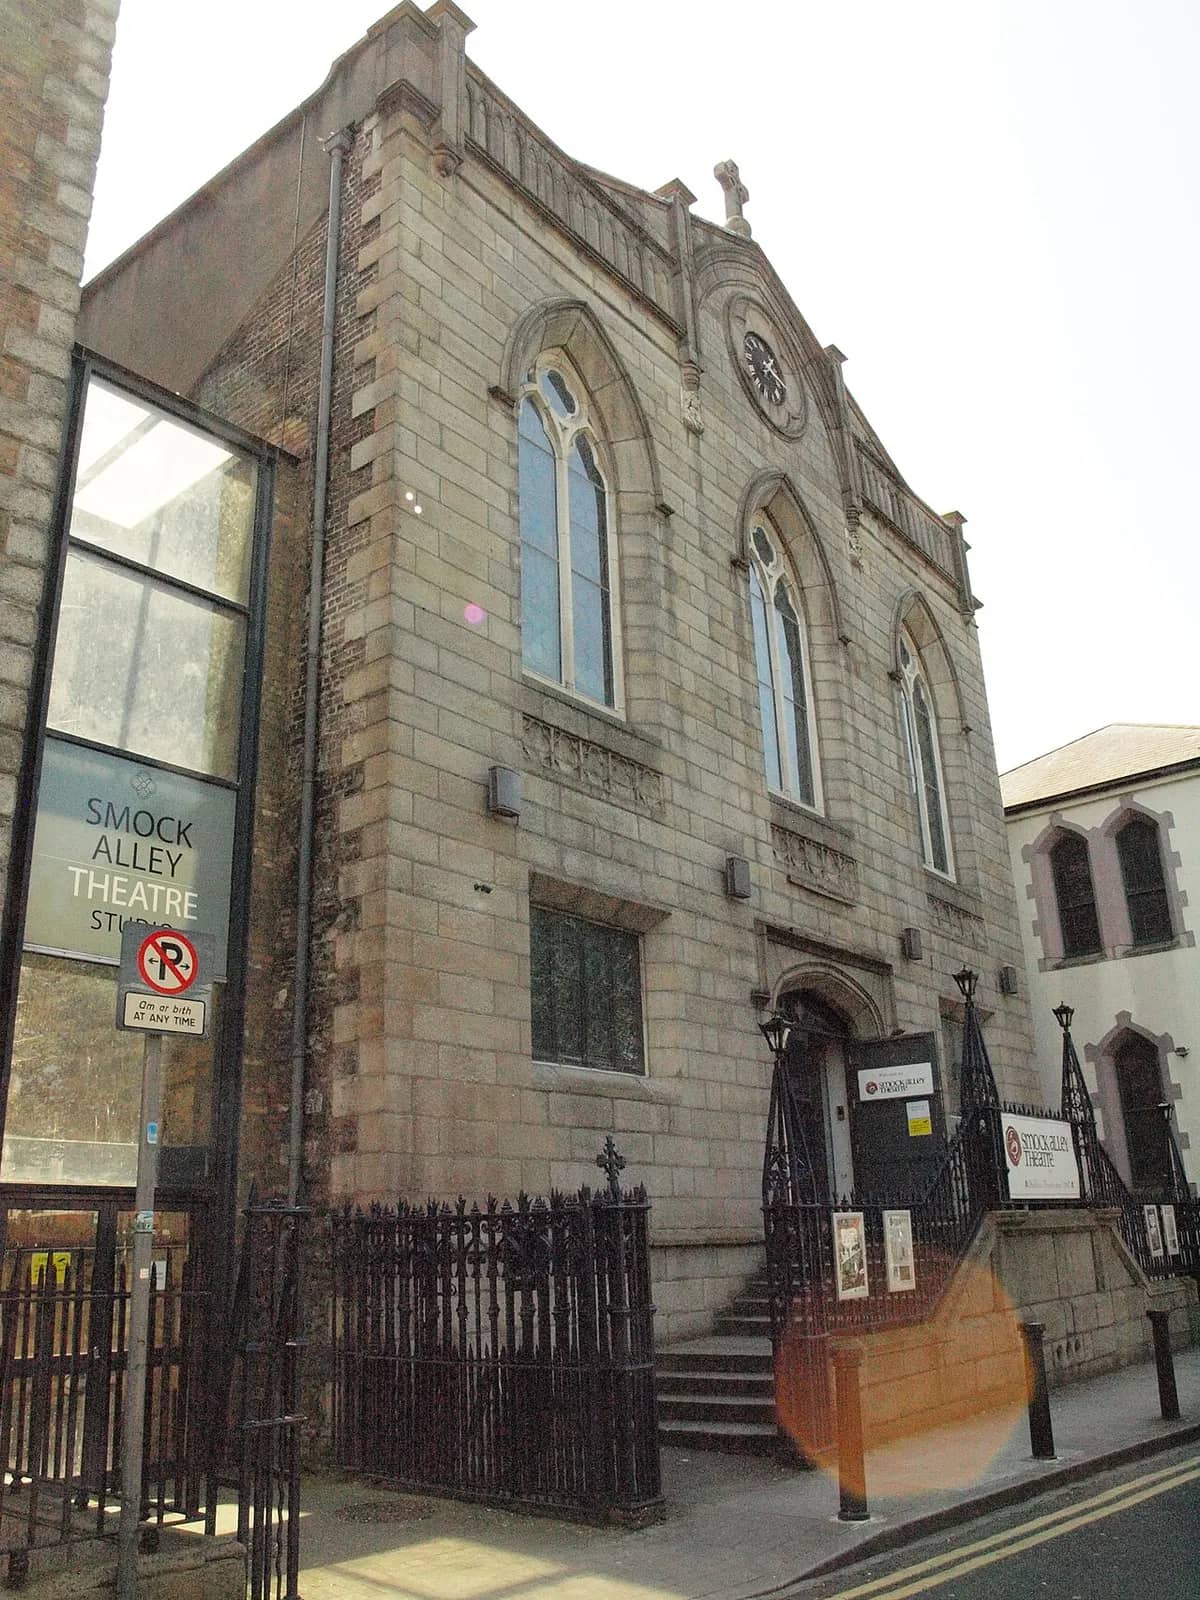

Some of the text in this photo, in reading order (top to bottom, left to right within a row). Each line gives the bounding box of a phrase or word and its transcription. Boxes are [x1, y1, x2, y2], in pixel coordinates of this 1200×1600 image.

[86, 798, 192, 848] SMOCK
[92, 835, 183, 877] ALLEY
[68, 866, 198, 920] THEATRE
[91, 910, 172, 933] STU
[134, 1011, 196, 1027] AT ANY TIME
